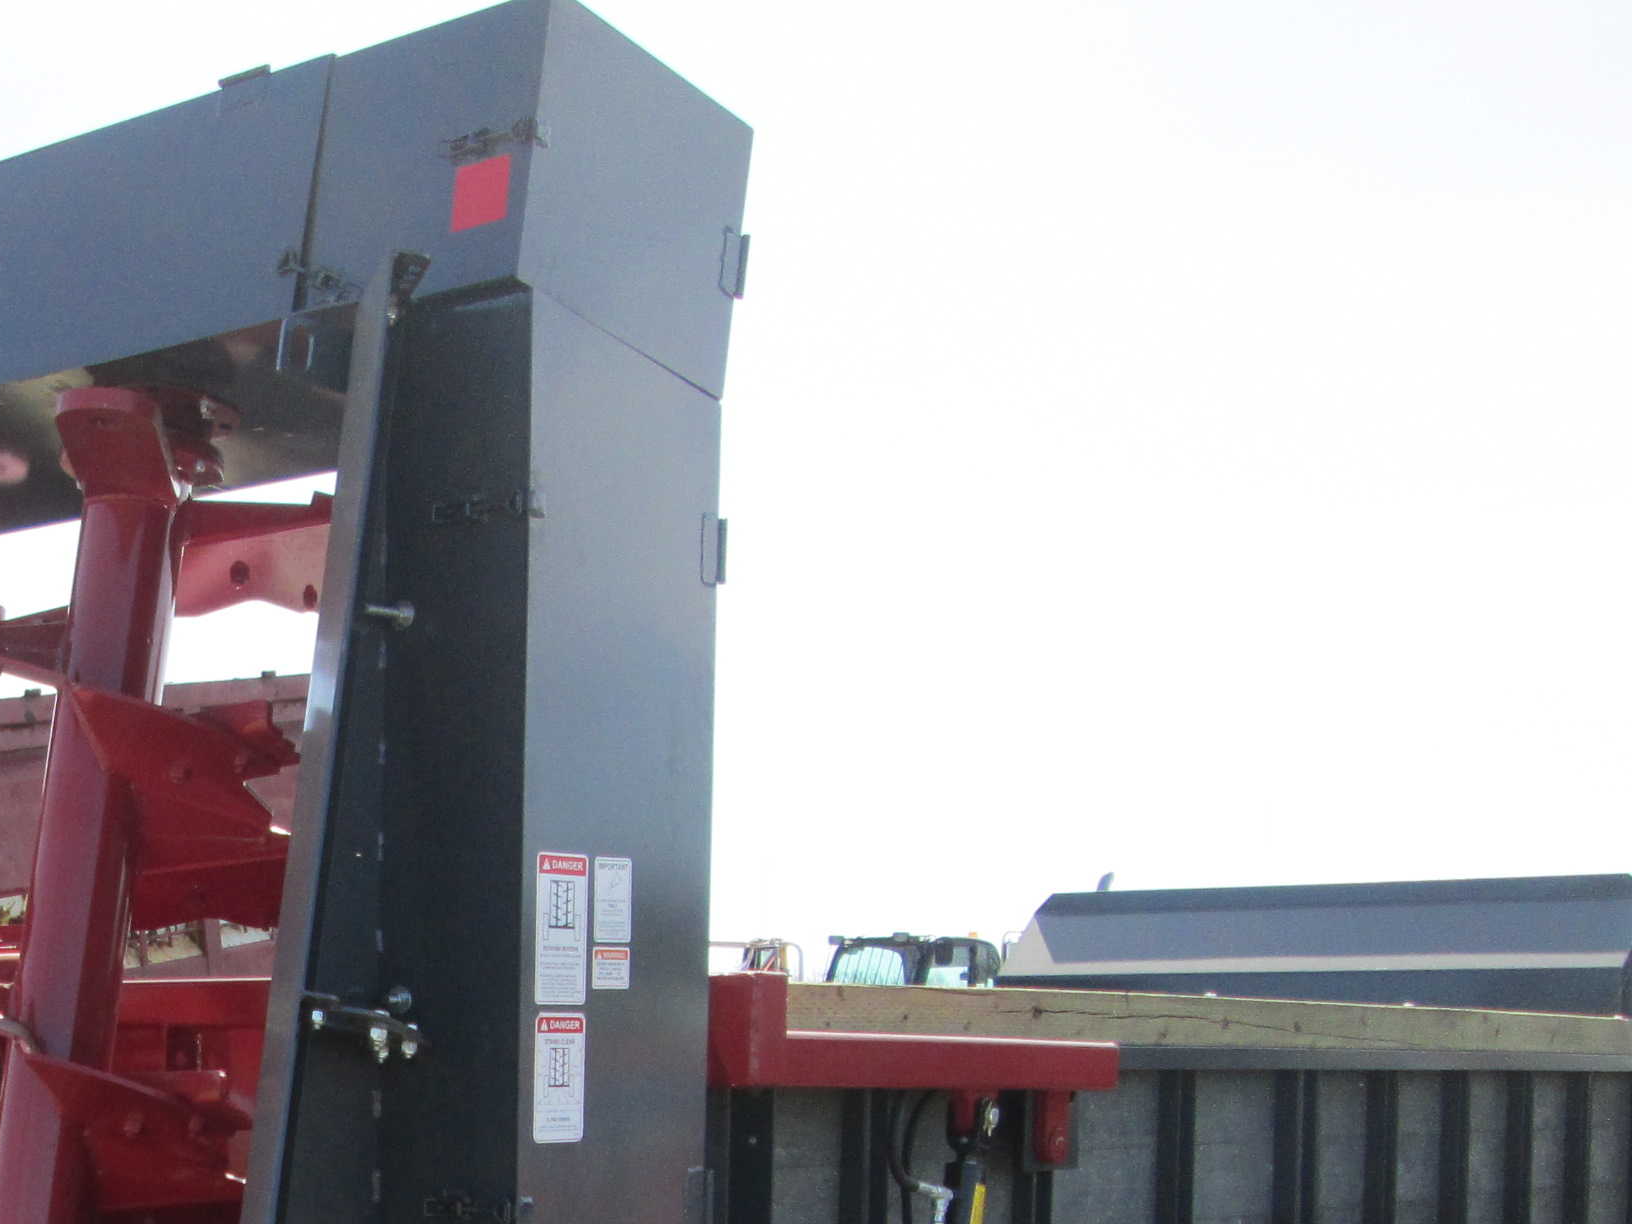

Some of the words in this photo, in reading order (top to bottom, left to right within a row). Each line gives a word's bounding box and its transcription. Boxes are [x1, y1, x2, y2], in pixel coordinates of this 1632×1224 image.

[551, 860, 583, 871] DANGER
[598, 862, 629, 870] IMPORTANT
[549, 1020, 580, 1030] DANGER
